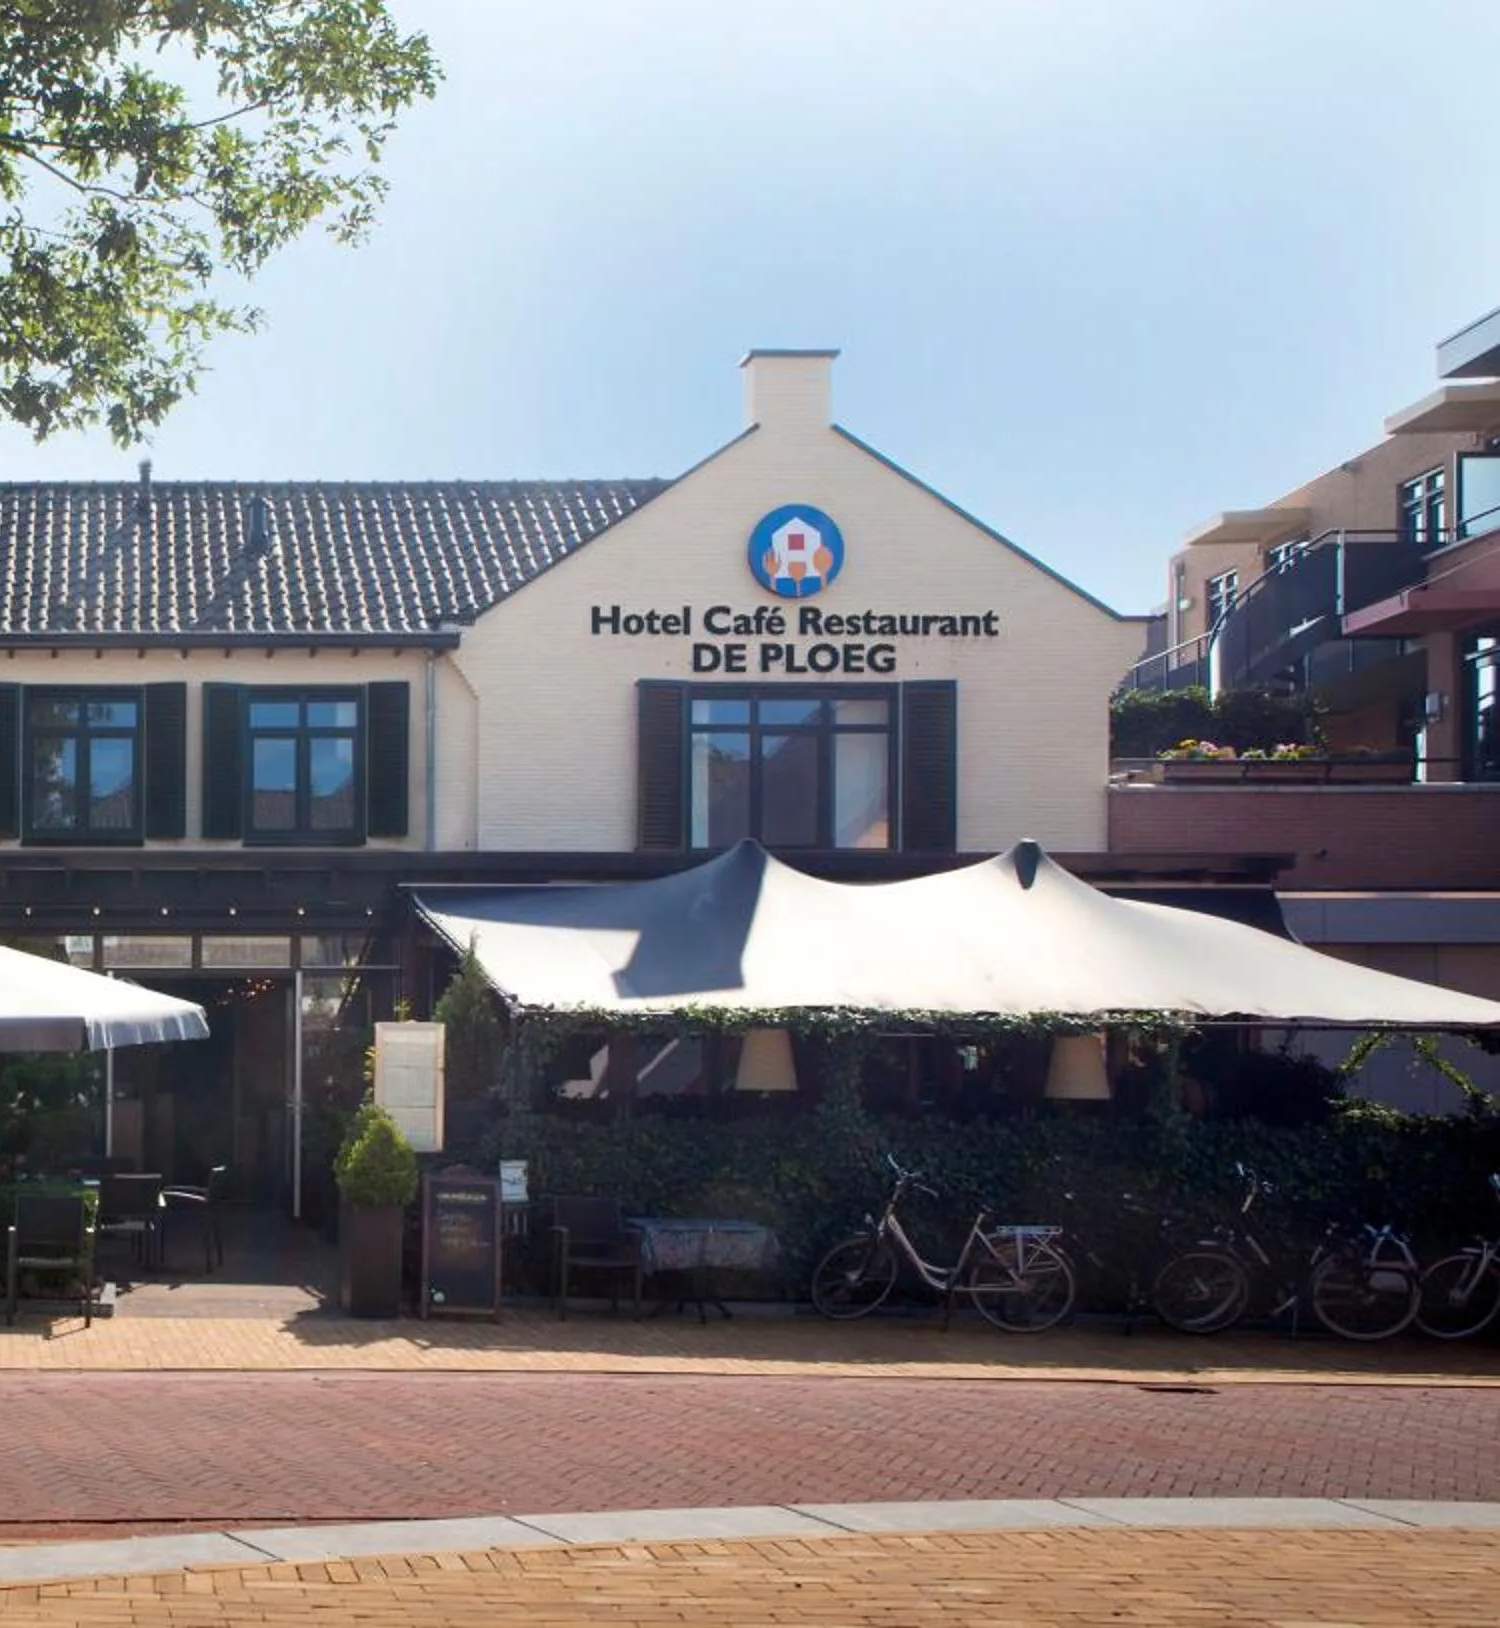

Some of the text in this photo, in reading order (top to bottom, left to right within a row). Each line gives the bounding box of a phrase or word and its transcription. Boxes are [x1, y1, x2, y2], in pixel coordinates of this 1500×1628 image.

[591, 605, 999, 637] Hotel Café Restaurant
[692, 643, 896, 674] DE PLOEG
